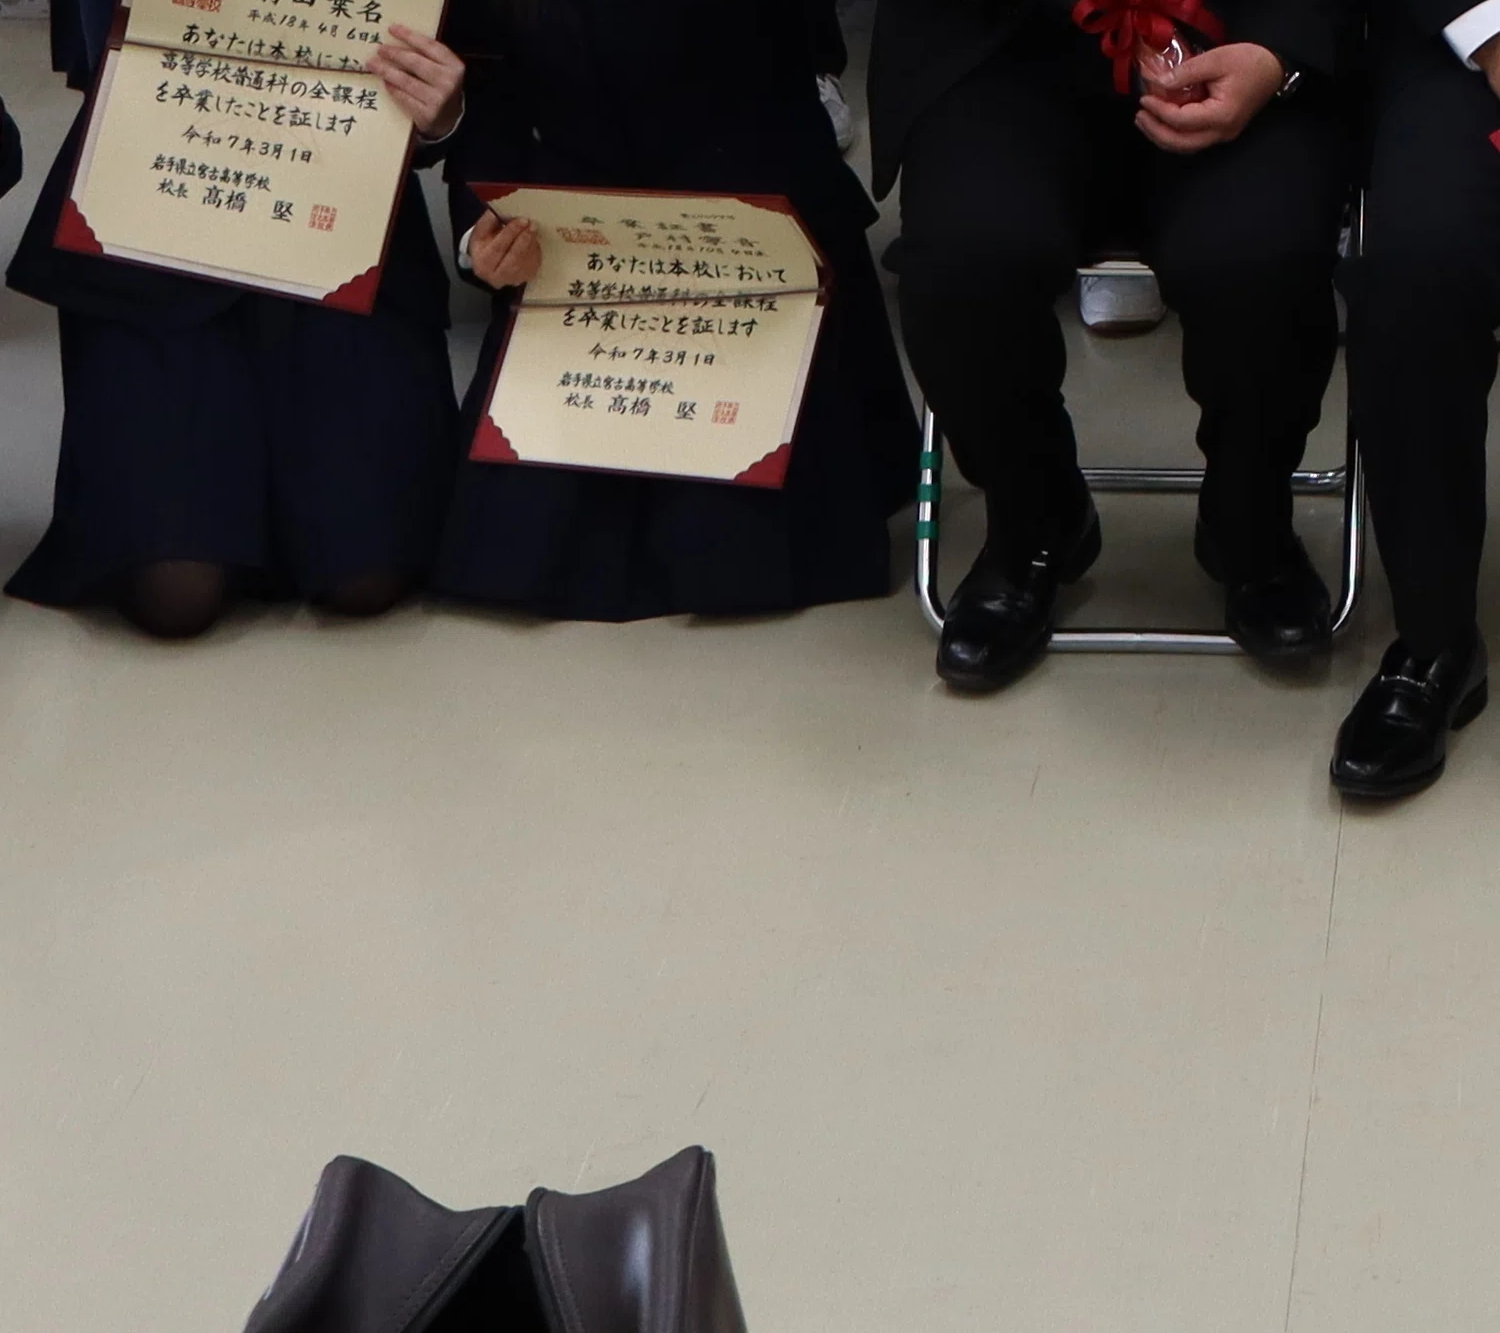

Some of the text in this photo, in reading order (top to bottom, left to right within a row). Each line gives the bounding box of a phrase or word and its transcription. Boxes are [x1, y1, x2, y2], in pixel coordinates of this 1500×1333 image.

[156, 81, 357, 135] を卒業したことを証します
[587, 253, 787, 282] あなたは本校において
[563, 308, 758, 337] を卒業したことを証します
[588, 343, 715, 365] 令和7年3月1日
